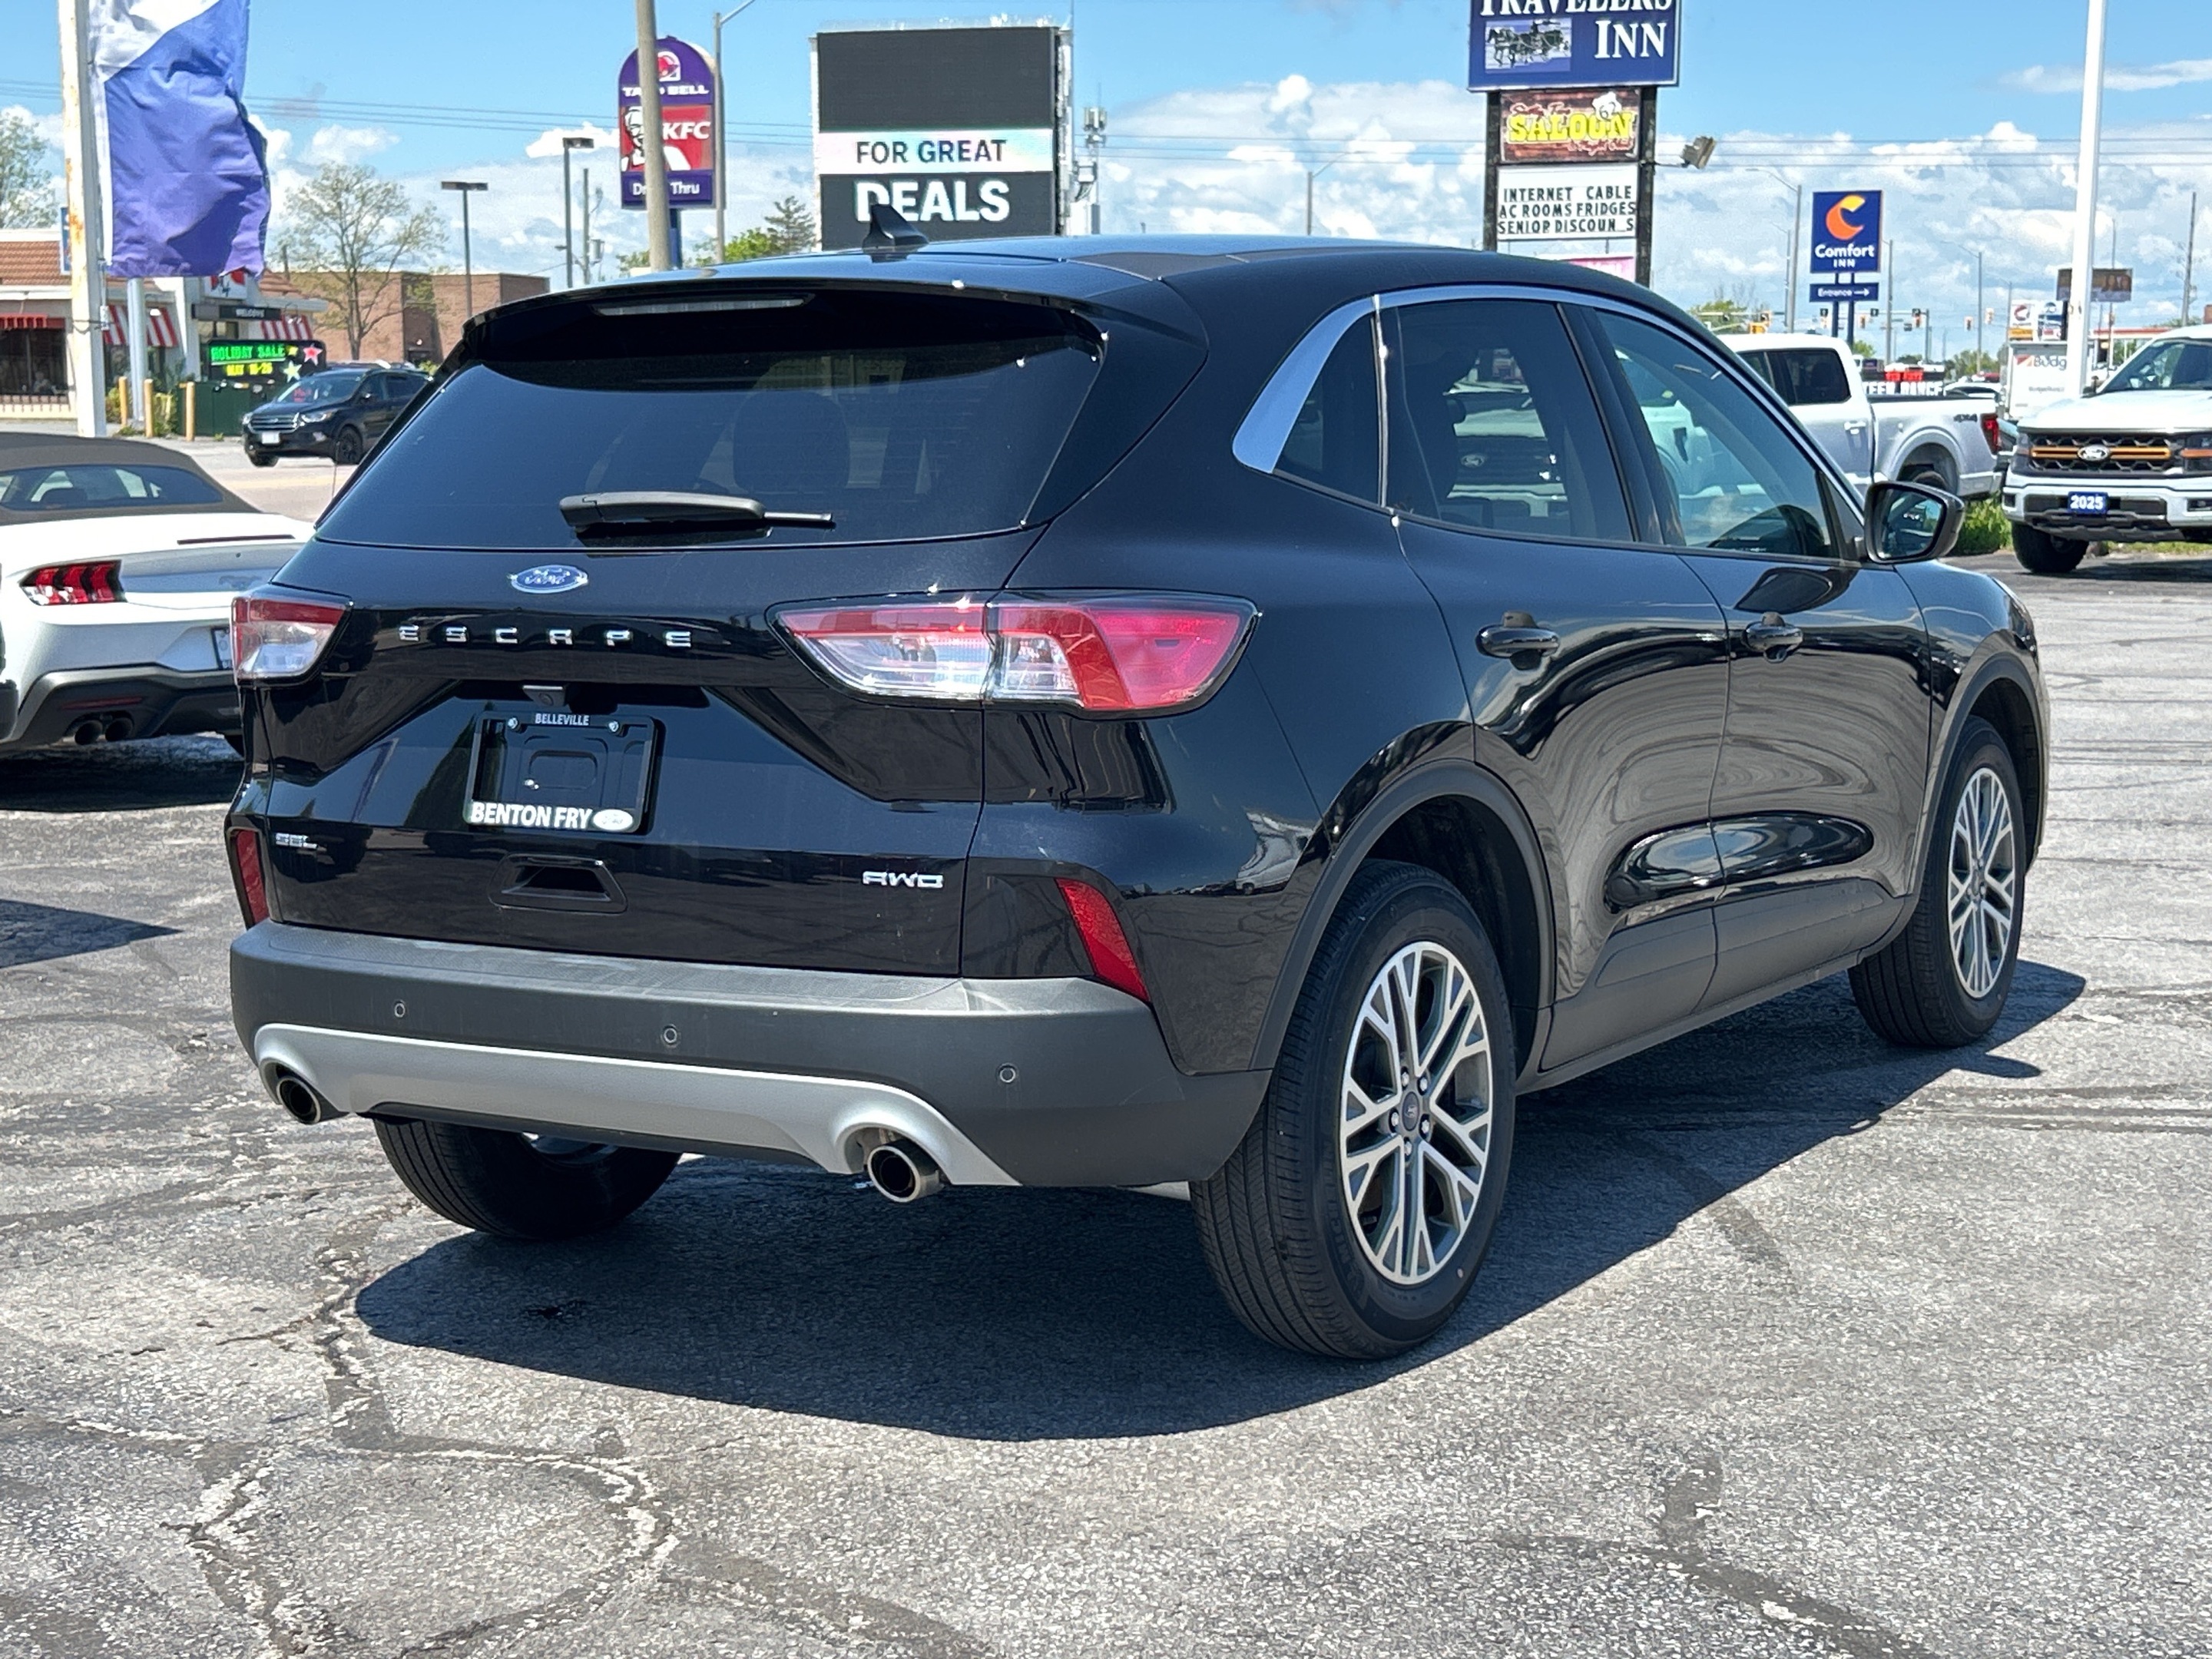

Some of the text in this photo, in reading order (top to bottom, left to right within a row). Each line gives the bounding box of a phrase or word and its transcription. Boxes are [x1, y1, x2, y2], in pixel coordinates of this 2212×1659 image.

[1594, 20, 1667, 59] INN
[622, 84, 710, 97] TA BELL
[662, 121, 711, 140] KFC
[856, 139, 1007, 164] FOR GREAT
[670, 181, 700, 195] Thru
[1503, 185, 1631, 203] INTERNET CABLE
[855, 179, 1011, 222] DEALS
[1499, 201, 1636, 219] AC ROOMS FRIDGES
[1814, 243, 1875, 258] Comfort
[1833, 258, 1856, 268] INN
[1817, 287, 1853, 297] Entrance
[257, 344, 286, 359] SALE
[2034, 356, 2067, 371] Budg
[2070, 494, 2104, 510] 2025
[399, 624, 691, 647] ESCAPE
[535, 713, 590, 726] BELLEVILLE
[471, 802, 551, 828] BENTON
[553, 807, 593, 830] FRY
[863, 870, 943, 889] AWD
